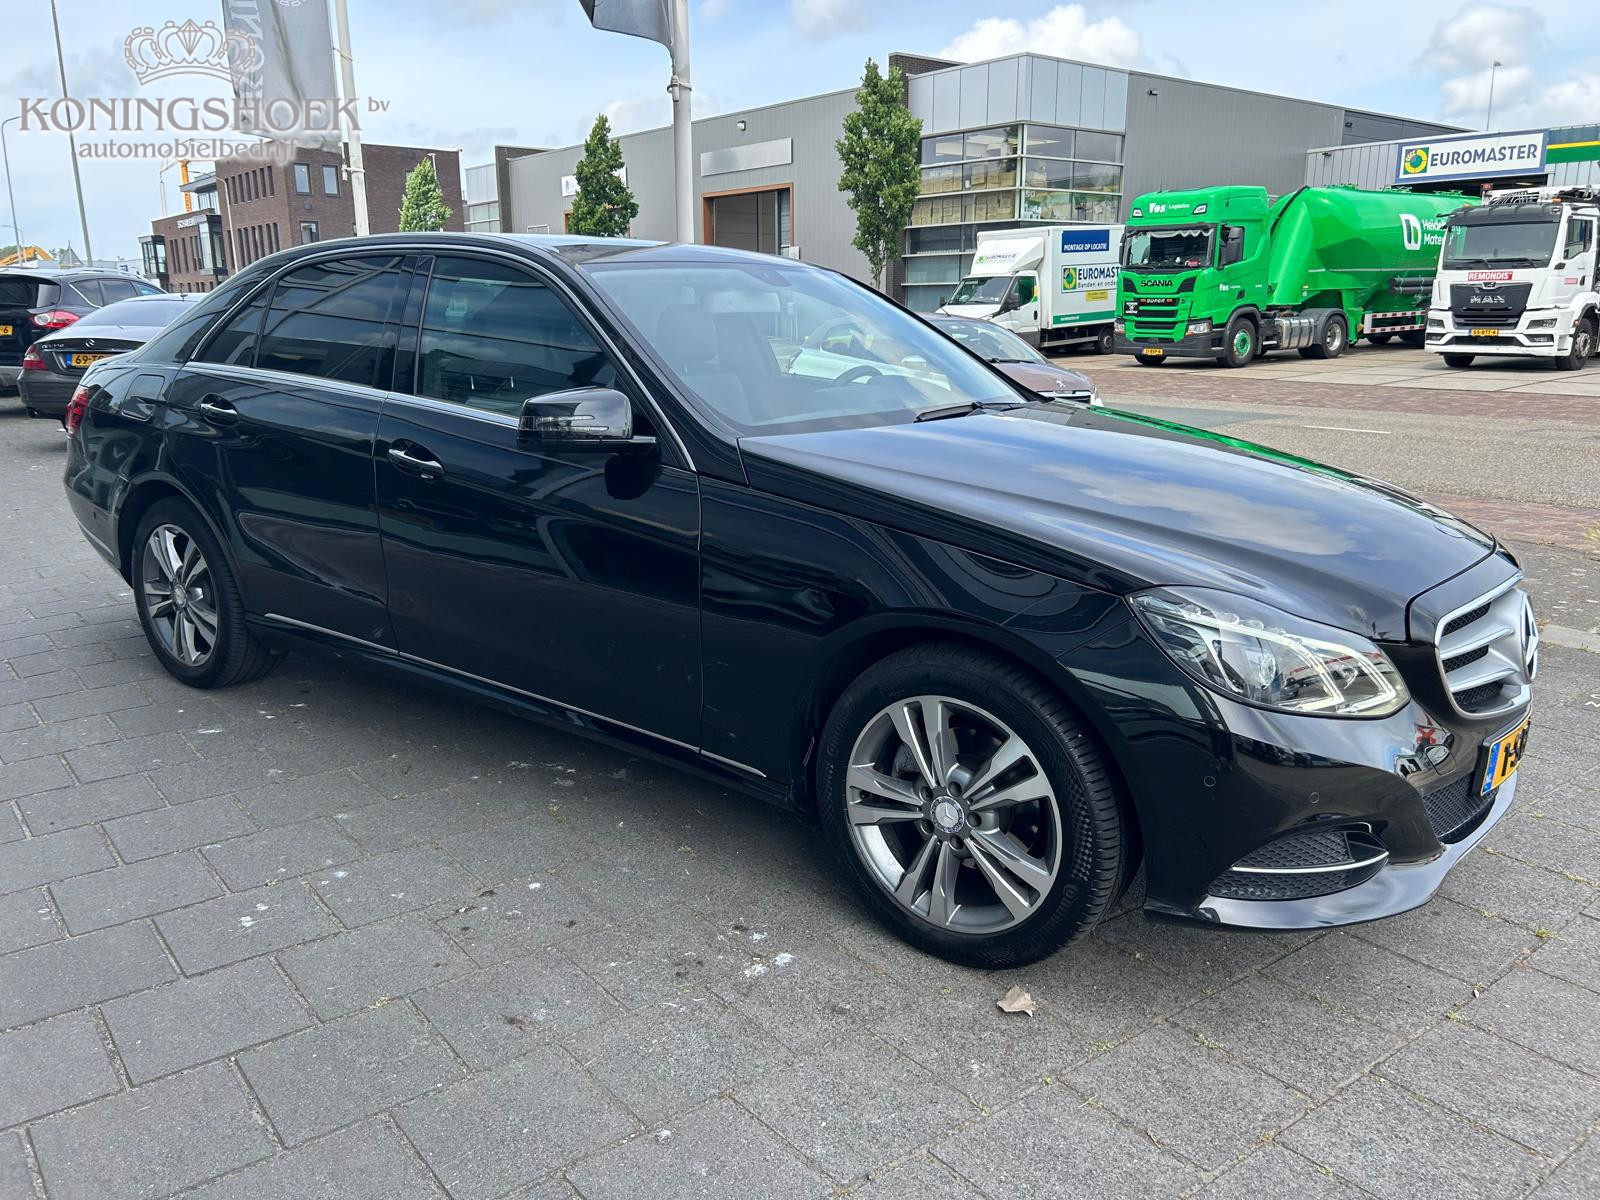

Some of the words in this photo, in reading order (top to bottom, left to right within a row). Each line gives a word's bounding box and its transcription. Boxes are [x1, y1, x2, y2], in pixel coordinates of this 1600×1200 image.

[1430, 143, 1538, 167] EUROMASTER
[1468, 272, 1509, 280] REMONDIS
[1140, 279, 1173, 287] SCANIA
[1470, 295, 1506, 304] MAN
